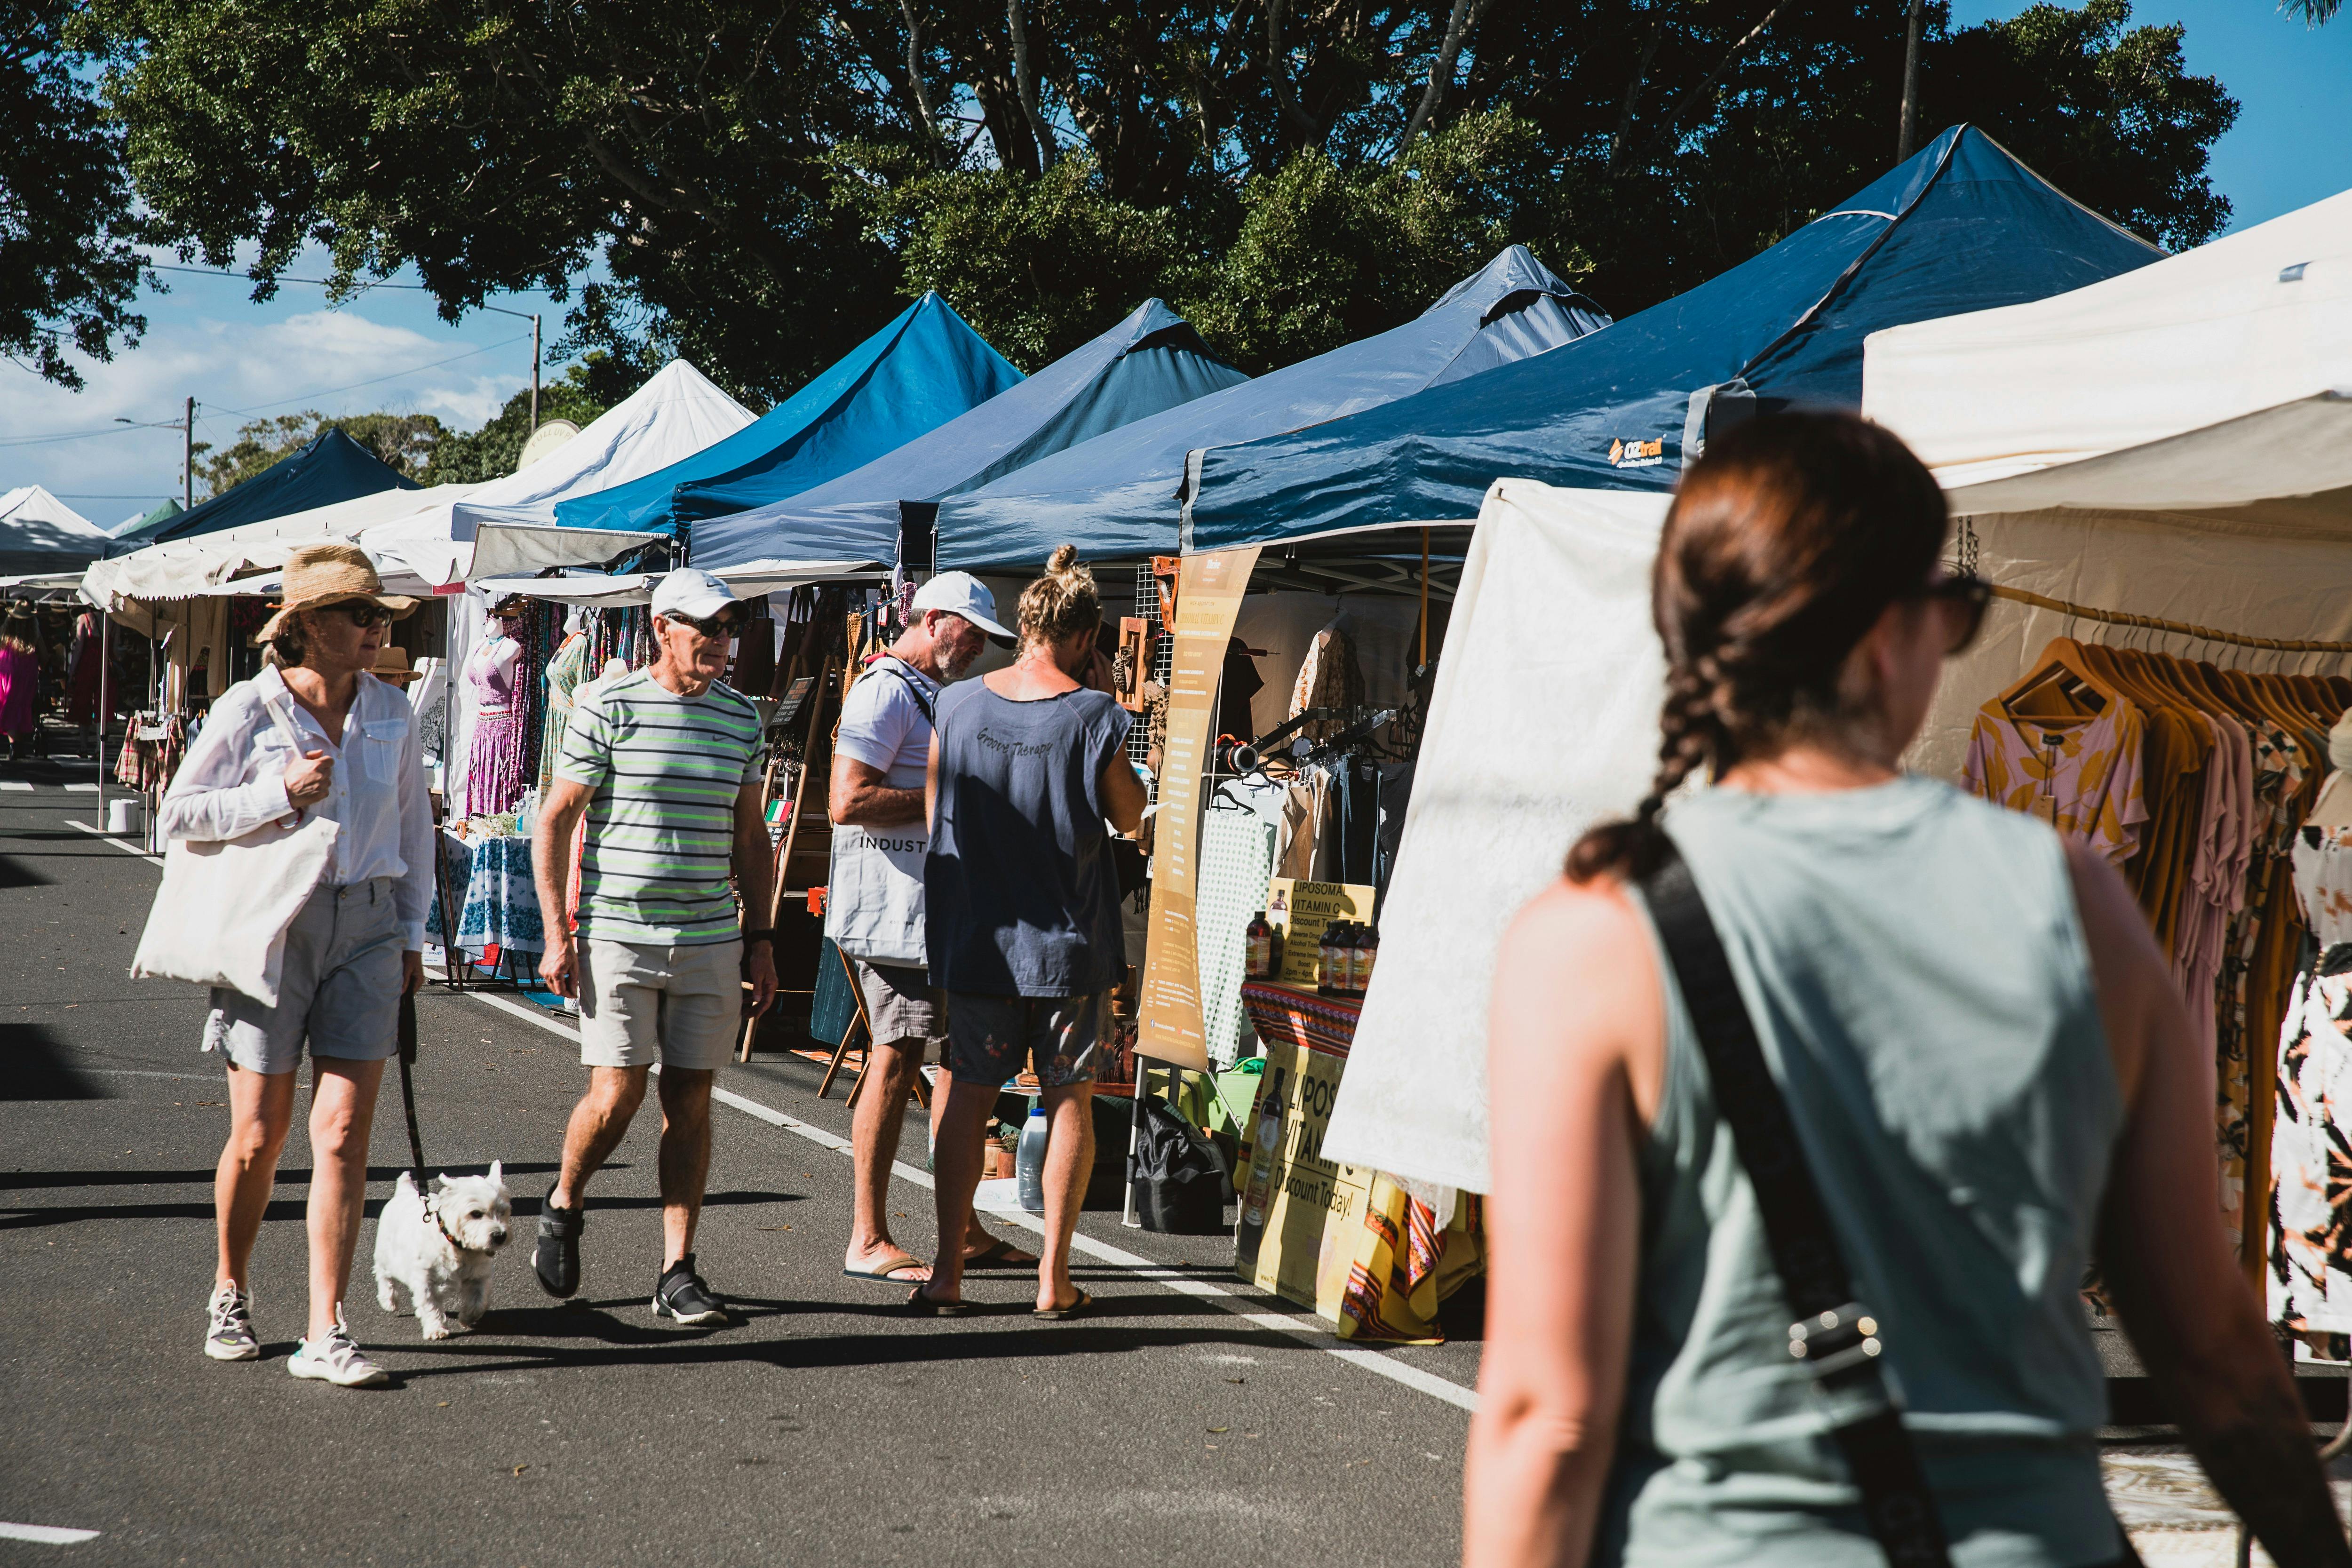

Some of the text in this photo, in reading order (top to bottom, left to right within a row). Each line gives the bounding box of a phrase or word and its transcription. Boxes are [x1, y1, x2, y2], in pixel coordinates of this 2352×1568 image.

[532, 429, 552, 447] FULL
[1220, 614, 1224, 625] C
[977, 727, 1053, 759] Groove Therapy
[860, 836, 926, 853] INDUST
[1294, 881, 1348, 897] LIPOSOMAL
[1292, 899, 1340, 914] VITAMIN C
[1290, 915, 1320, 927] Discount
[1309, 932, 1320, 940] Drug
[1286, 968, 1297, 976] 2pm
[1302, 970, 1313, 978] 4pm
[1289, 1072, 1336, 1121] LIPOS
[1274, 1166, 1353, 1221] Discount Today!
